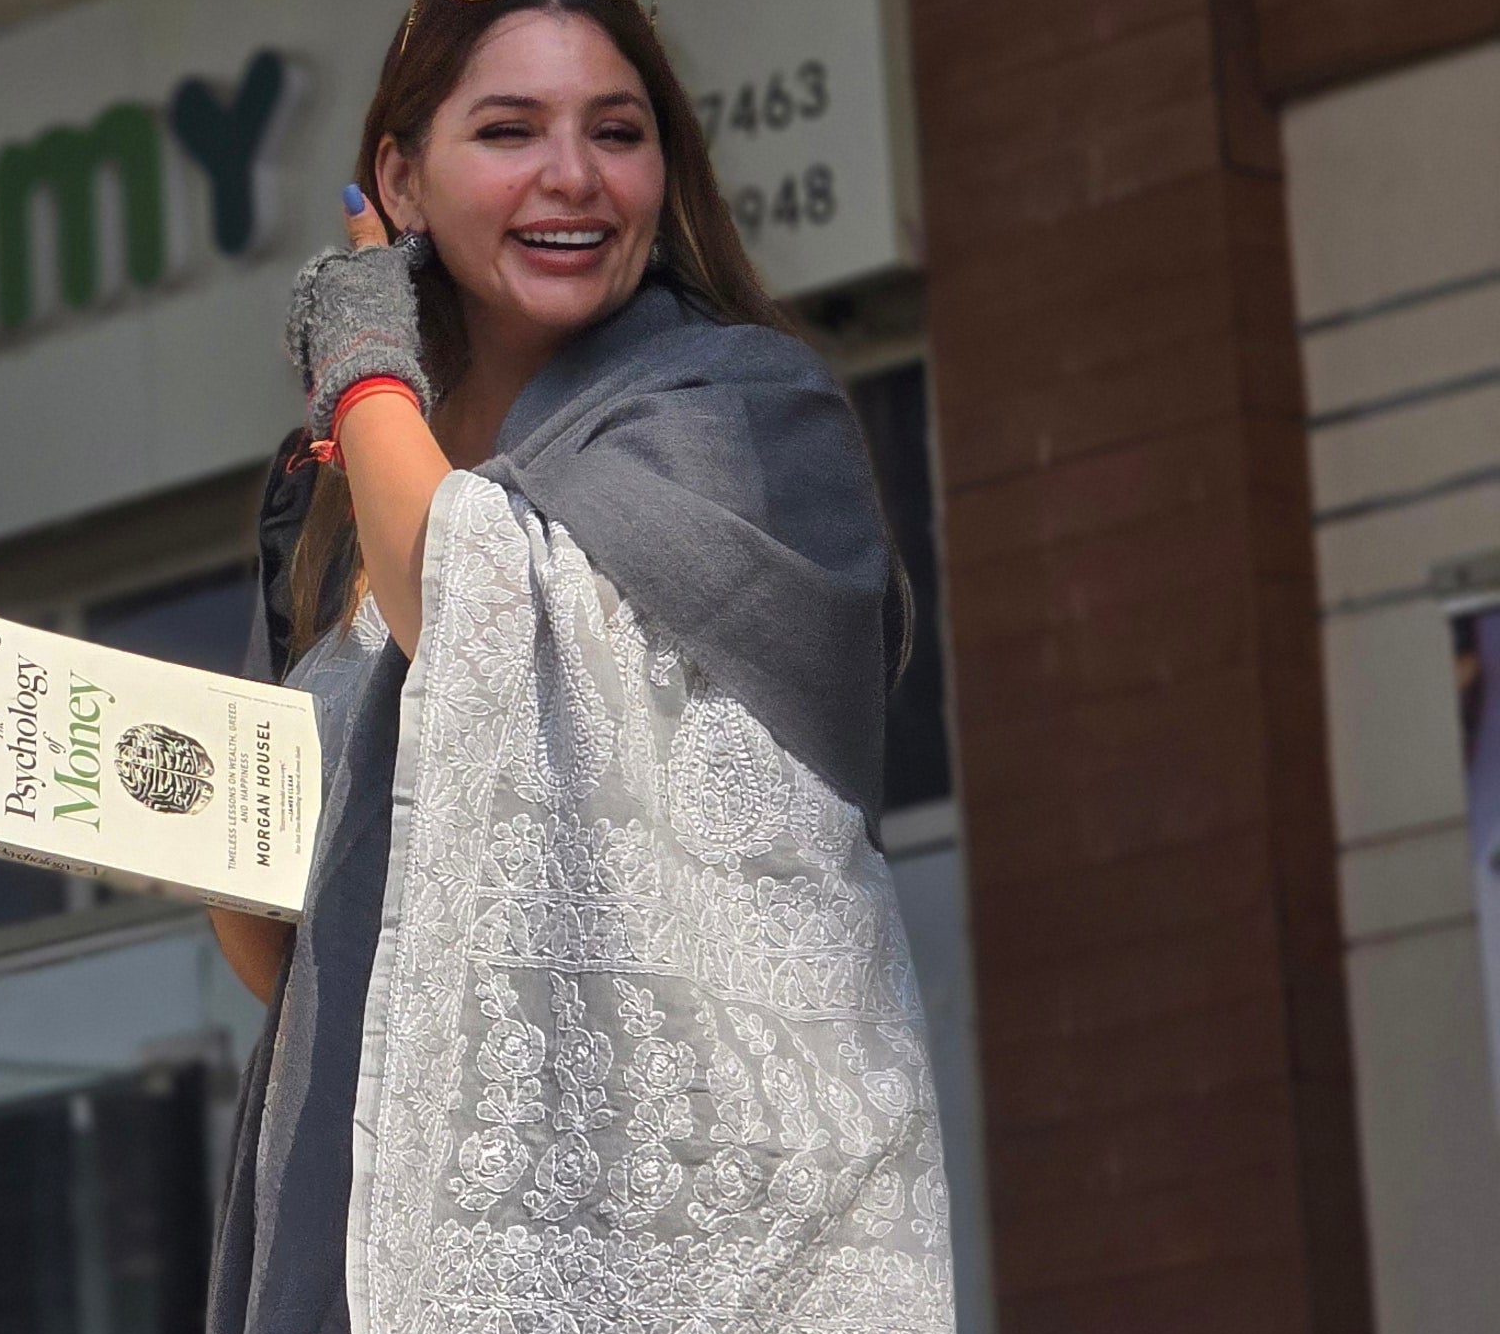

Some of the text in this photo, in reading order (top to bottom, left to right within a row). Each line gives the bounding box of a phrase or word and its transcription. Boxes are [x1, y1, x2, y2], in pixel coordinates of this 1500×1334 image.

[5, 653, 48, 822] Psychology
[43, 731, 66, 755] of
[53, 669, 115, 833] Money
[228, 735, 238, 769] WEALTH,
[228, 771, 237, 785] ON
[240, 752, 249, 823] AND HAPPINESS
[257, 720, 270, 867] MORGAN HOUSEL
[228, 786, 237, 826] LESSONS
[228, 828, 237, 870] TIMELESS
